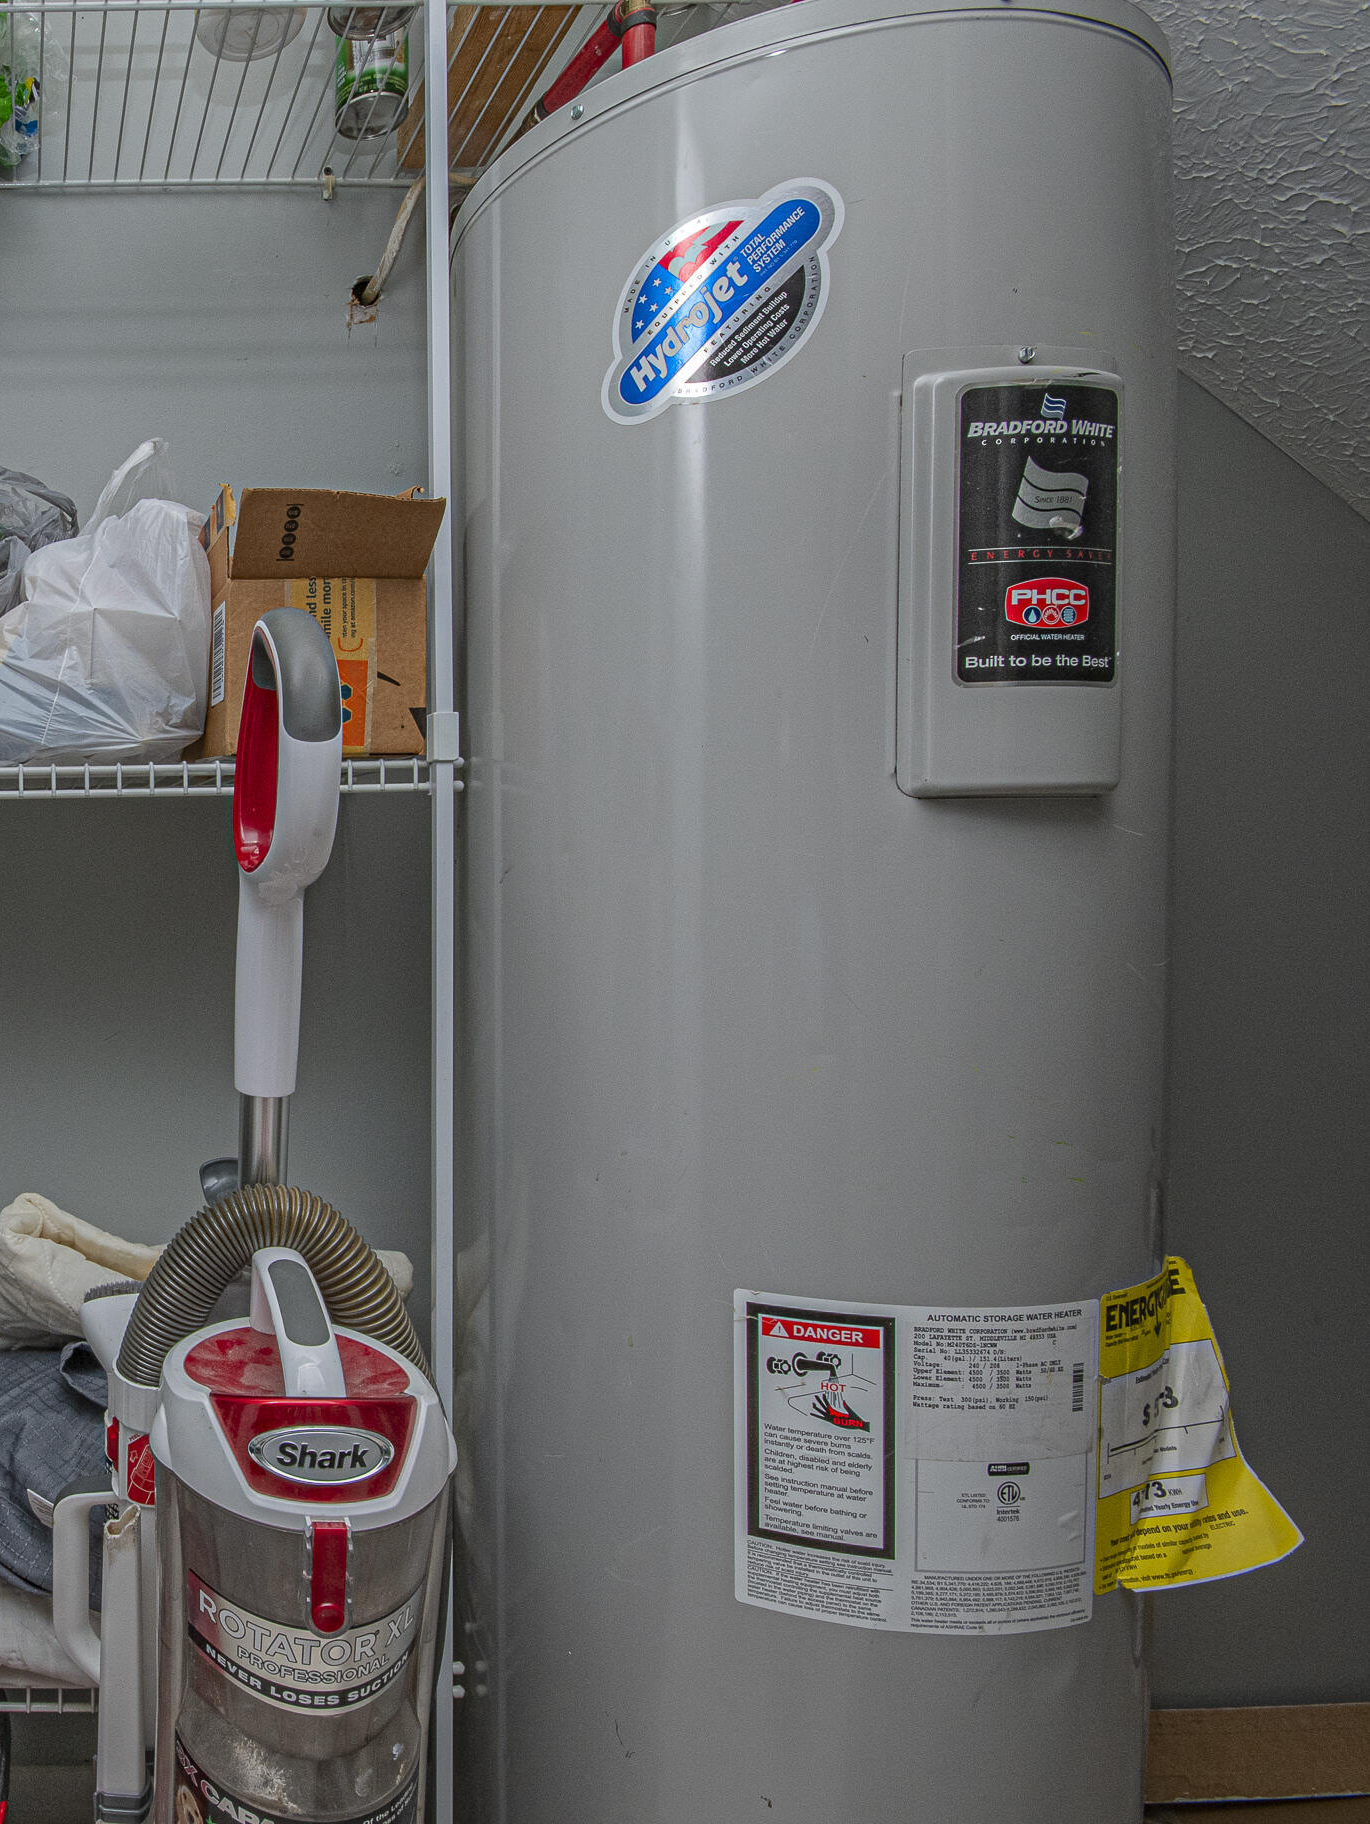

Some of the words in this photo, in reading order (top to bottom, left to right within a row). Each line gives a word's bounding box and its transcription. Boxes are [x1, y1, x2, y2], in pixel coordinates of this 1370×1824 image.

[740, 233, 766, 257] TOTAL
[747, 206, 805, 265] PERFORMANCE
[753, 239, 786, 272] SYSTEM
[624, 280, 640, 313] MADE
[645, 255, 656, 268] IN
[647, 274, 703, 335] EQUIPPED
[710, 235, 739, 265] WITH
[704, 286, 771, 353] FEATURING
[750, 345, 785, 373] WHITE
[789, 257, 818, 339] CORPORATION
[710, 340, 737, 366] Reduced
[735, 312, 765, 341] Sediment
[762, 291, 788, 315] Buildup
[724, 347, 744, 366] Lower
[742, 321, 774, 349] Operating
[771, 304, 790, 321] Costs
[740, 347, 758, 364] More
[756, 336, 770, 349] Hot
[768, 319, 788, 338] Water
[967, 420, 1068, 438] BRADFORD
[1071, 420, 1115, 438] WHITE
[981, 437, 1105, 447] CORPORATION
[971, 550, 1053, 561] ENERGY
[1066, 550, 1112, 559] SAVER
[1011, 589, 1086, 605] PHCC
[965, 655, 1005, 669] Built
[1009, 656, 1027, 666] to
[1031, 654, 1051, 666] be
[1056, 654, 1079, 666] the
[1082, 655, 1109, 668] Best
[927, 1314, 981, 1322] AUTOMATIC
[1026, 1312, 1052, 1320] WATER
[1054, 1309, 1082, 1318] HEATER
[793, 1325, 863, 1343] DANGER
[821, 1381, 846, 1392] HOT
[943, 1402, 964, 1410] rating
[834, 1417, 863, 1427] BURN
[764, 1423, 789, 1432] Water
[788, 1427, 832, 1439] temperature
[853, 1436, 875, 1444] 125°F
[779, 1434, 801, 1442] cause
[804, 1438, 828, 1446] severe
[830, 1440, 851, 1450] burns
[276, 1440, 369, 1470] Shark
[764, 1439, 794, 1450] instantly
[805, 1444, 826, 1454] death
[829, 1448, 845, 1456] from
[847, 1450, 873, 1460] scalds.
[764, 1448, 797, 1460] Children,
[799, 1454, 830, 1465] disabled
[832, 1458, 846, 1466] and
[848, 1460, 872, 1471] elderly
[764, 1464, 795, 1474] scalded.
[787, 1459, 814, 1470] highest
[816, 1464, 829, 1472] risk
[830, 1465, 838, 1473] of
[840, 1467, 860, 1477] being
[764, 1473, 779, 1482] See
[781, 1475, 818, 1488] instruction
[820, 1483, 847, 1493] manual
[850, 1486, 873, 1496] before
[764, 1481, 788, 1491] setting
[790, 1485, 835, 1498] temperature
[846, 1494, 867, 1502] water
[764, 1487, 789, 1497] heater.
[764, 1496, 780, 1505] Feel
[782, 1500, 802, 1509] water
[804, 1504, 828, 1514] before
[830, 1508, 857, 1519] bathing
[764, 1504, 803, 1517] showering.
[1154, 1503, 1171, 1511] Yearly
[1171, 1501, 1191, 1510] Energy
[764, 1514, 810, 1529] Temperature
[812, 1523, 838, 1534] limiting
[840, 1528, 863, 1537] valves
[764, 1522, 799, 1534] available,
[816, 1531, 845, 1541] manual.
[1162, 1524, 1172, 1533] on
[1174, 1522, 1189, 1535] your
[1217, 1510, 1230, 1520] and
[1232, 1509, 1249, 1518] use.
[1210, 1521, 1235, 1531] ELECTRIC
[199, 1588, 378, 1666] ROTATOR
[385, 1604, 414, 1648] XL
[206, 1643, 262, 1690] NEVER
[270, 1685, 340, 1706] LOSES
[347, 1652, 409, 1702] SUCTION
[237, 1644, 389, 1684] PROFESSIONAL
